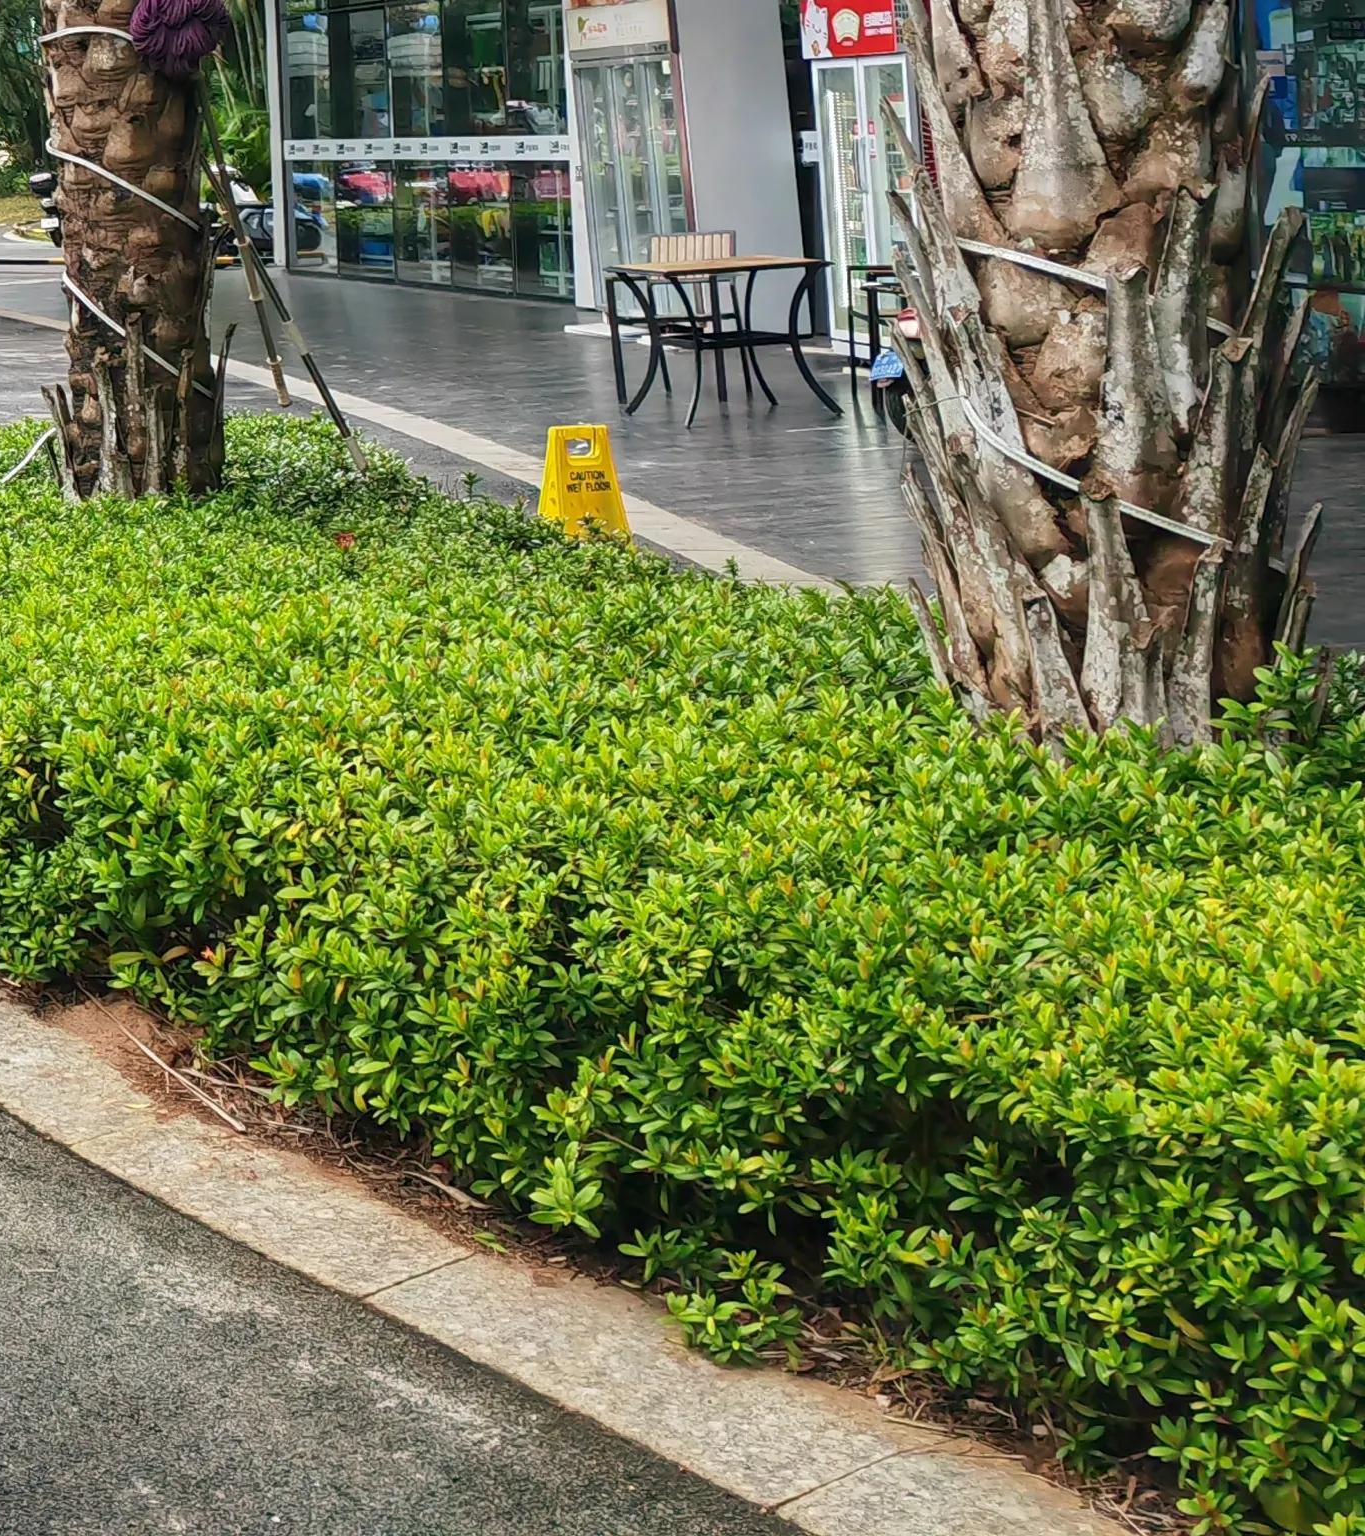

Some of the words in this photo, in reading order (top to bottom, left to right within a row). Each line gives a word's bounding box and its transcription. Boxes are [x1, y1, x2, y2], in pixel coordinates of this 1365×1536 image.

[569, 470, 605, 481] CAUTION
[566, 482, 582, 493] WET
[586, 481, 612, 492] FLOOR
